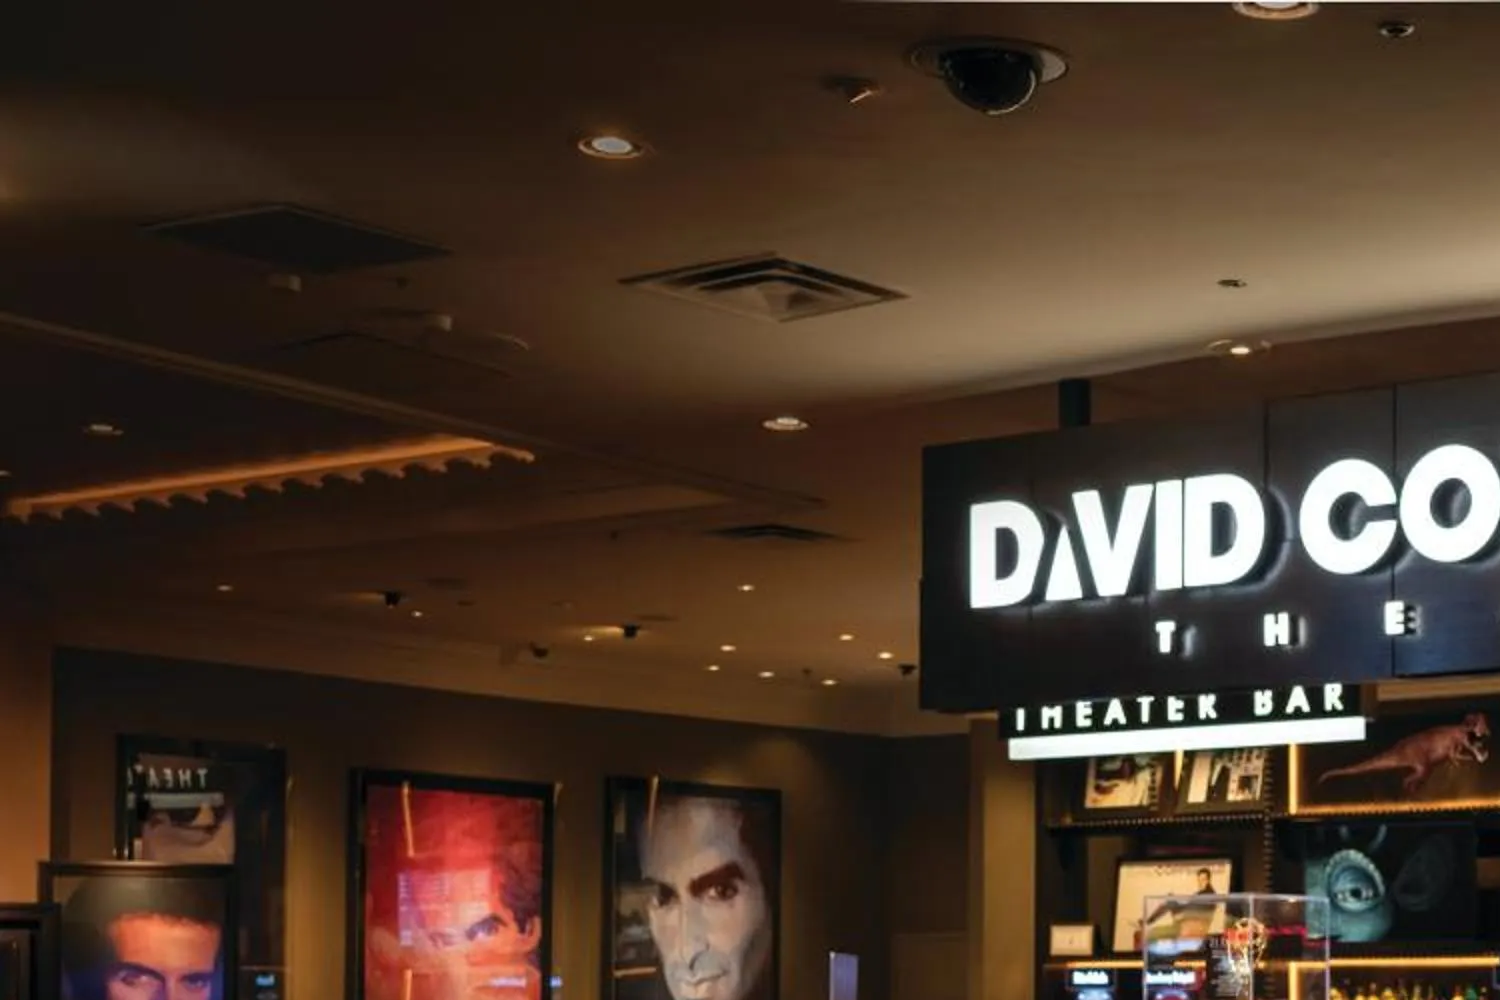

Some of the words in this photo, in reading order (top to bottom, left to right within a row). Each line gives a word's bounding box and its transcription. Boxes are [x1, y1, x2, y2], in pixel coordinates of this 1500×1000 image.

[970, 474, 1265, 608] DAVID
[1016, 694, 1218, 732] THEATER
[1254, 682, 1345, 717] BAR
